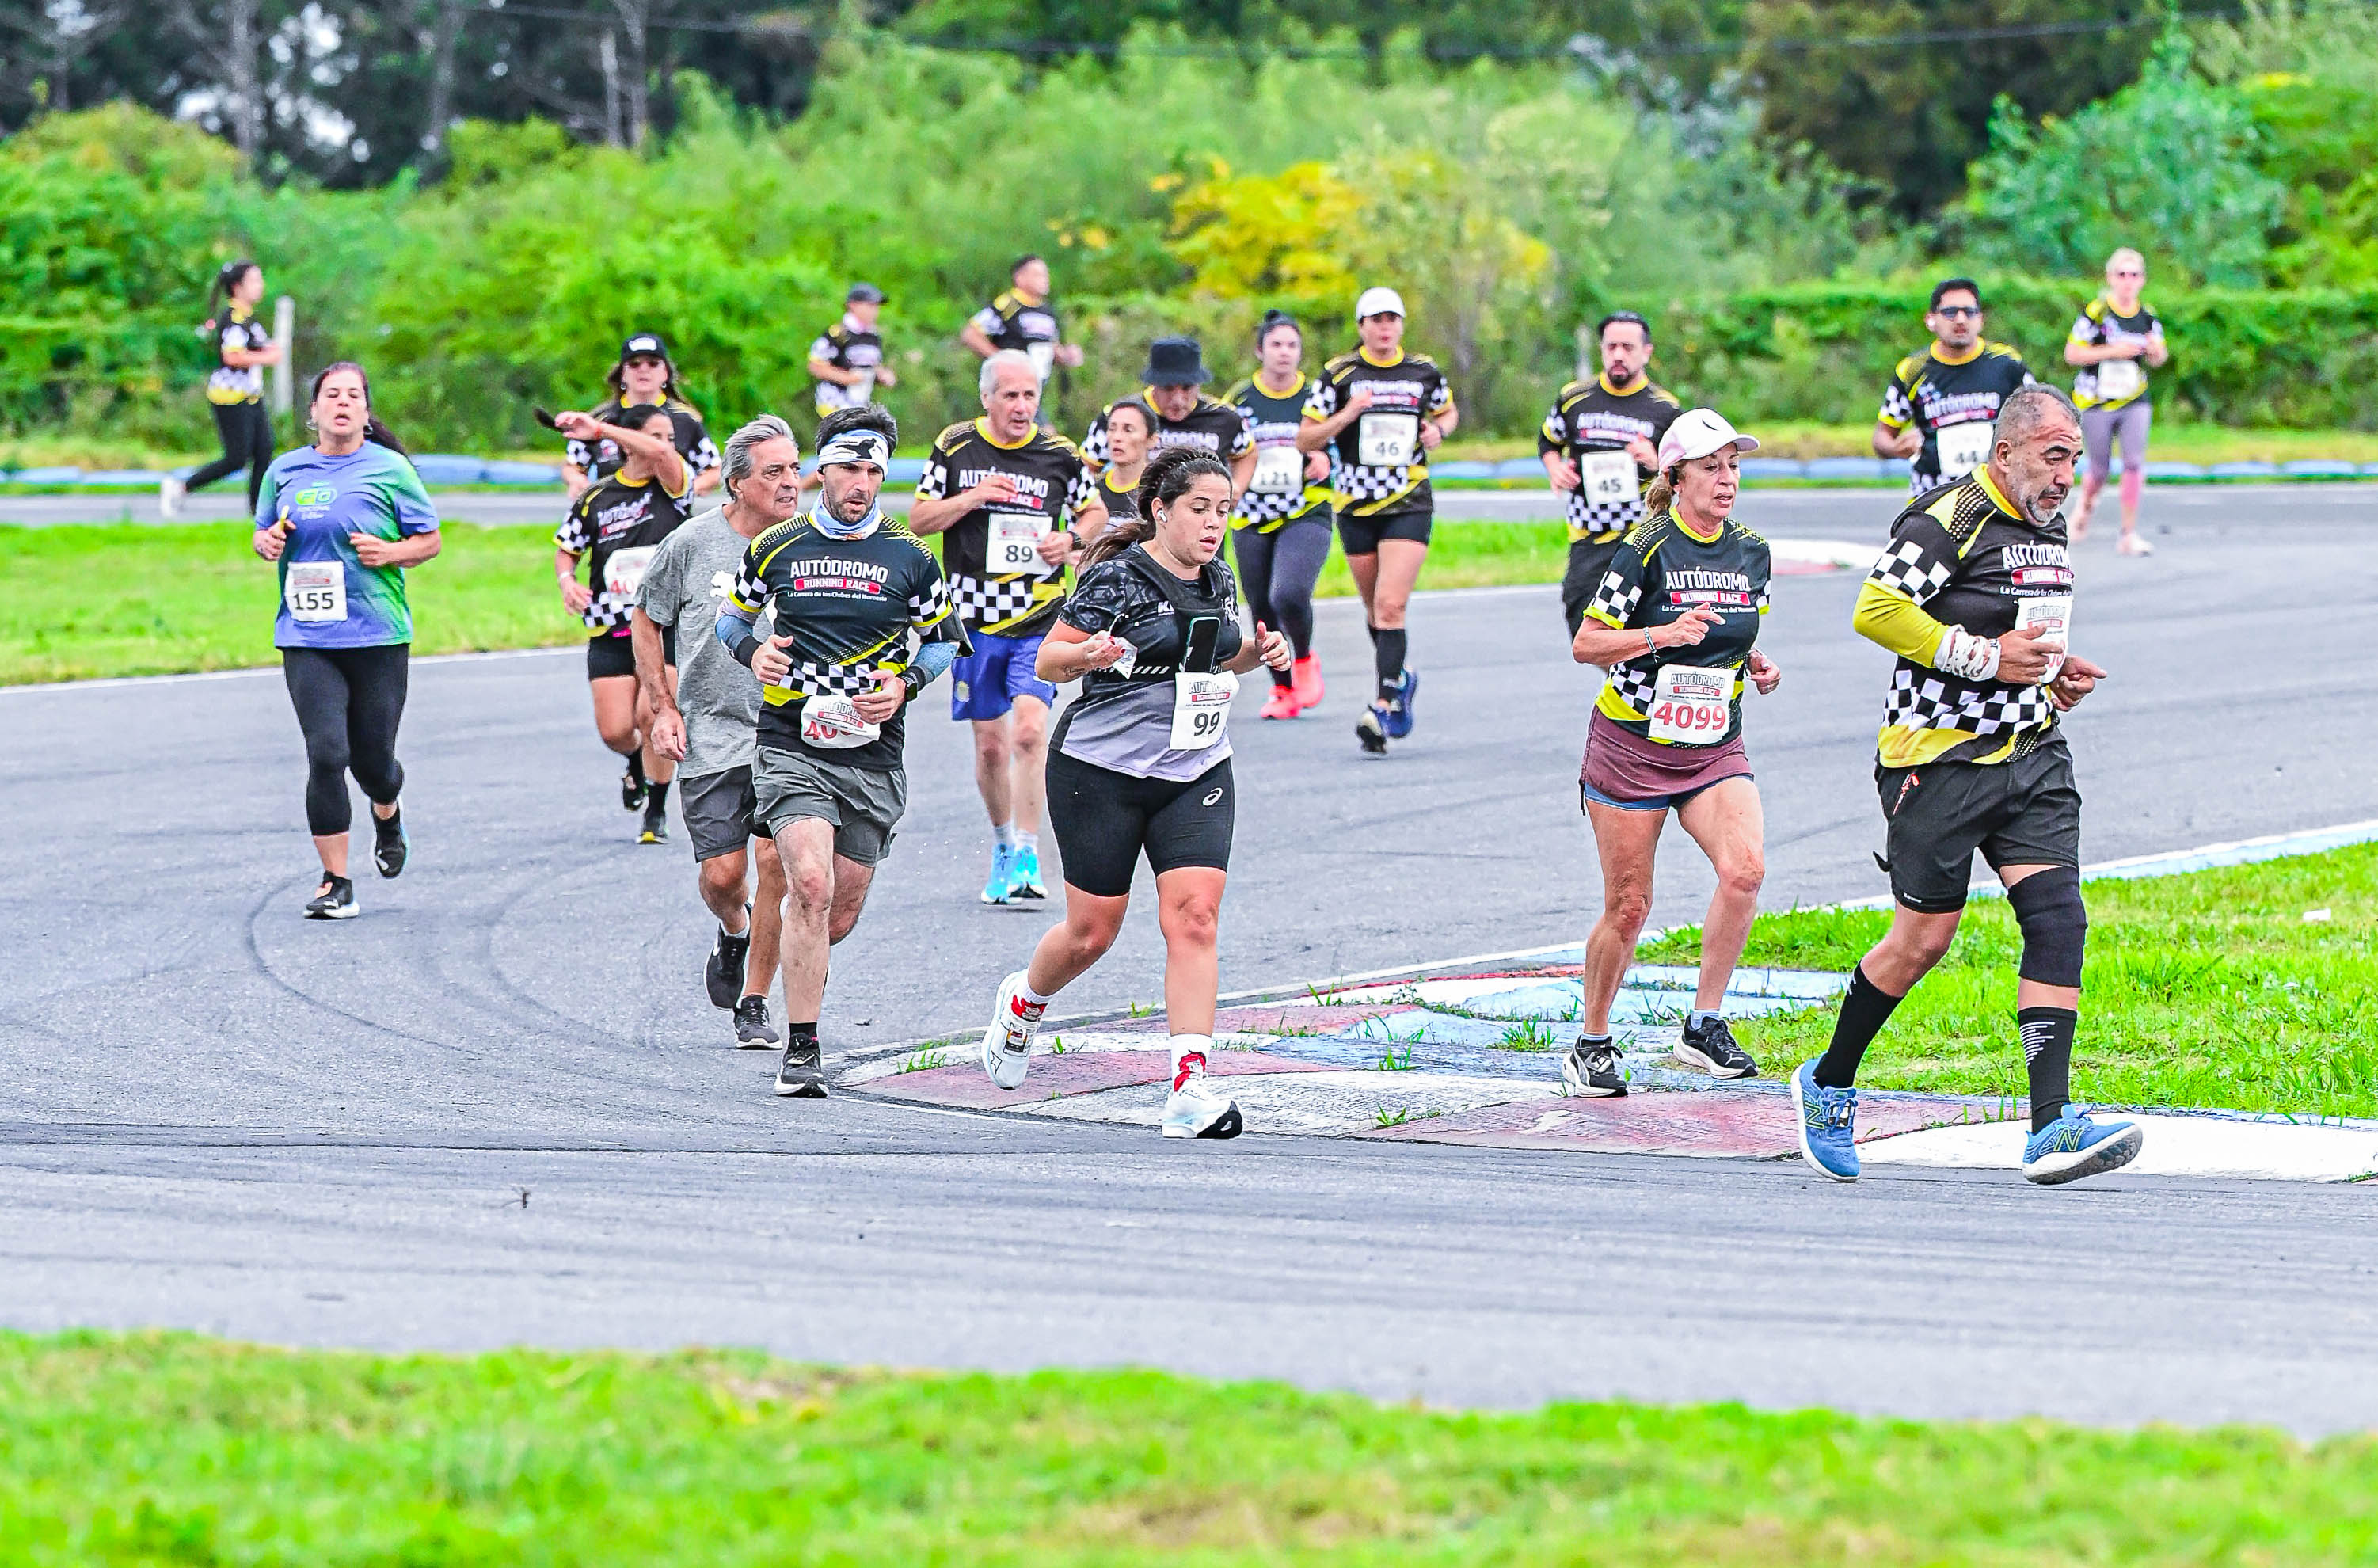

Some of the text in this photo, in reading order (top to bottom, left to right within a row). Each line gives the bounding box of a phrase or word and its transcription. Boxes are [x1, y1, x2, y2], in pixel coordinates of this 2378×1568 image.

[1375, 442, 1399, 457] 46
[1599, 478, 1622, 493] 45
[1006, 545, 1033, 562] 89
[789, 555, 888, 584] AUTÓDROMO
[803, 578, 870, 592] RUNNING RACE
[1665, 565, 1751, 592] AUTÓDROMO
[1680, 592, 1742, 603] RUNNING RACE
[2011, 586, 2034, 596] Carrera
[294, 592, 334, 611] 155
[1670, 672, 1725, 688] AUTÓDROMO
[1194, 712, 1220, 737] 99
[1654, 702, 1726, 730] 4099
[2053, 1128, 2084, 1152] N
